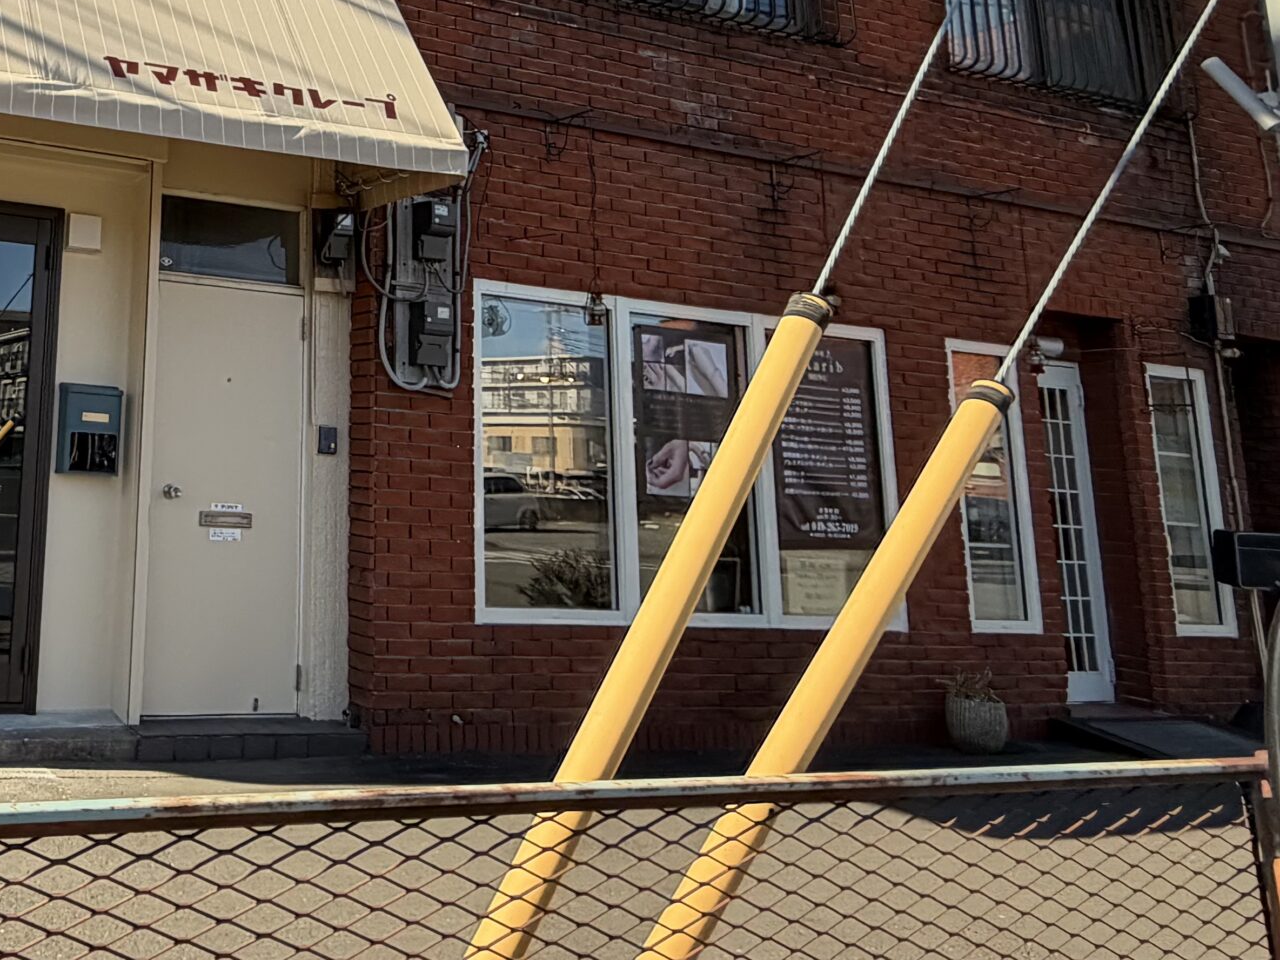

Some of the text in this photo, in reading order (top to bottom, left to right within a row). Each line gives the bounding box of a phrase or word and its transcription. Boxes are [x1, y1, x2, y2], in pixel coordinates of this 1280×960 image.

[104, 55, 398, 120] ヤマザキクレープ
